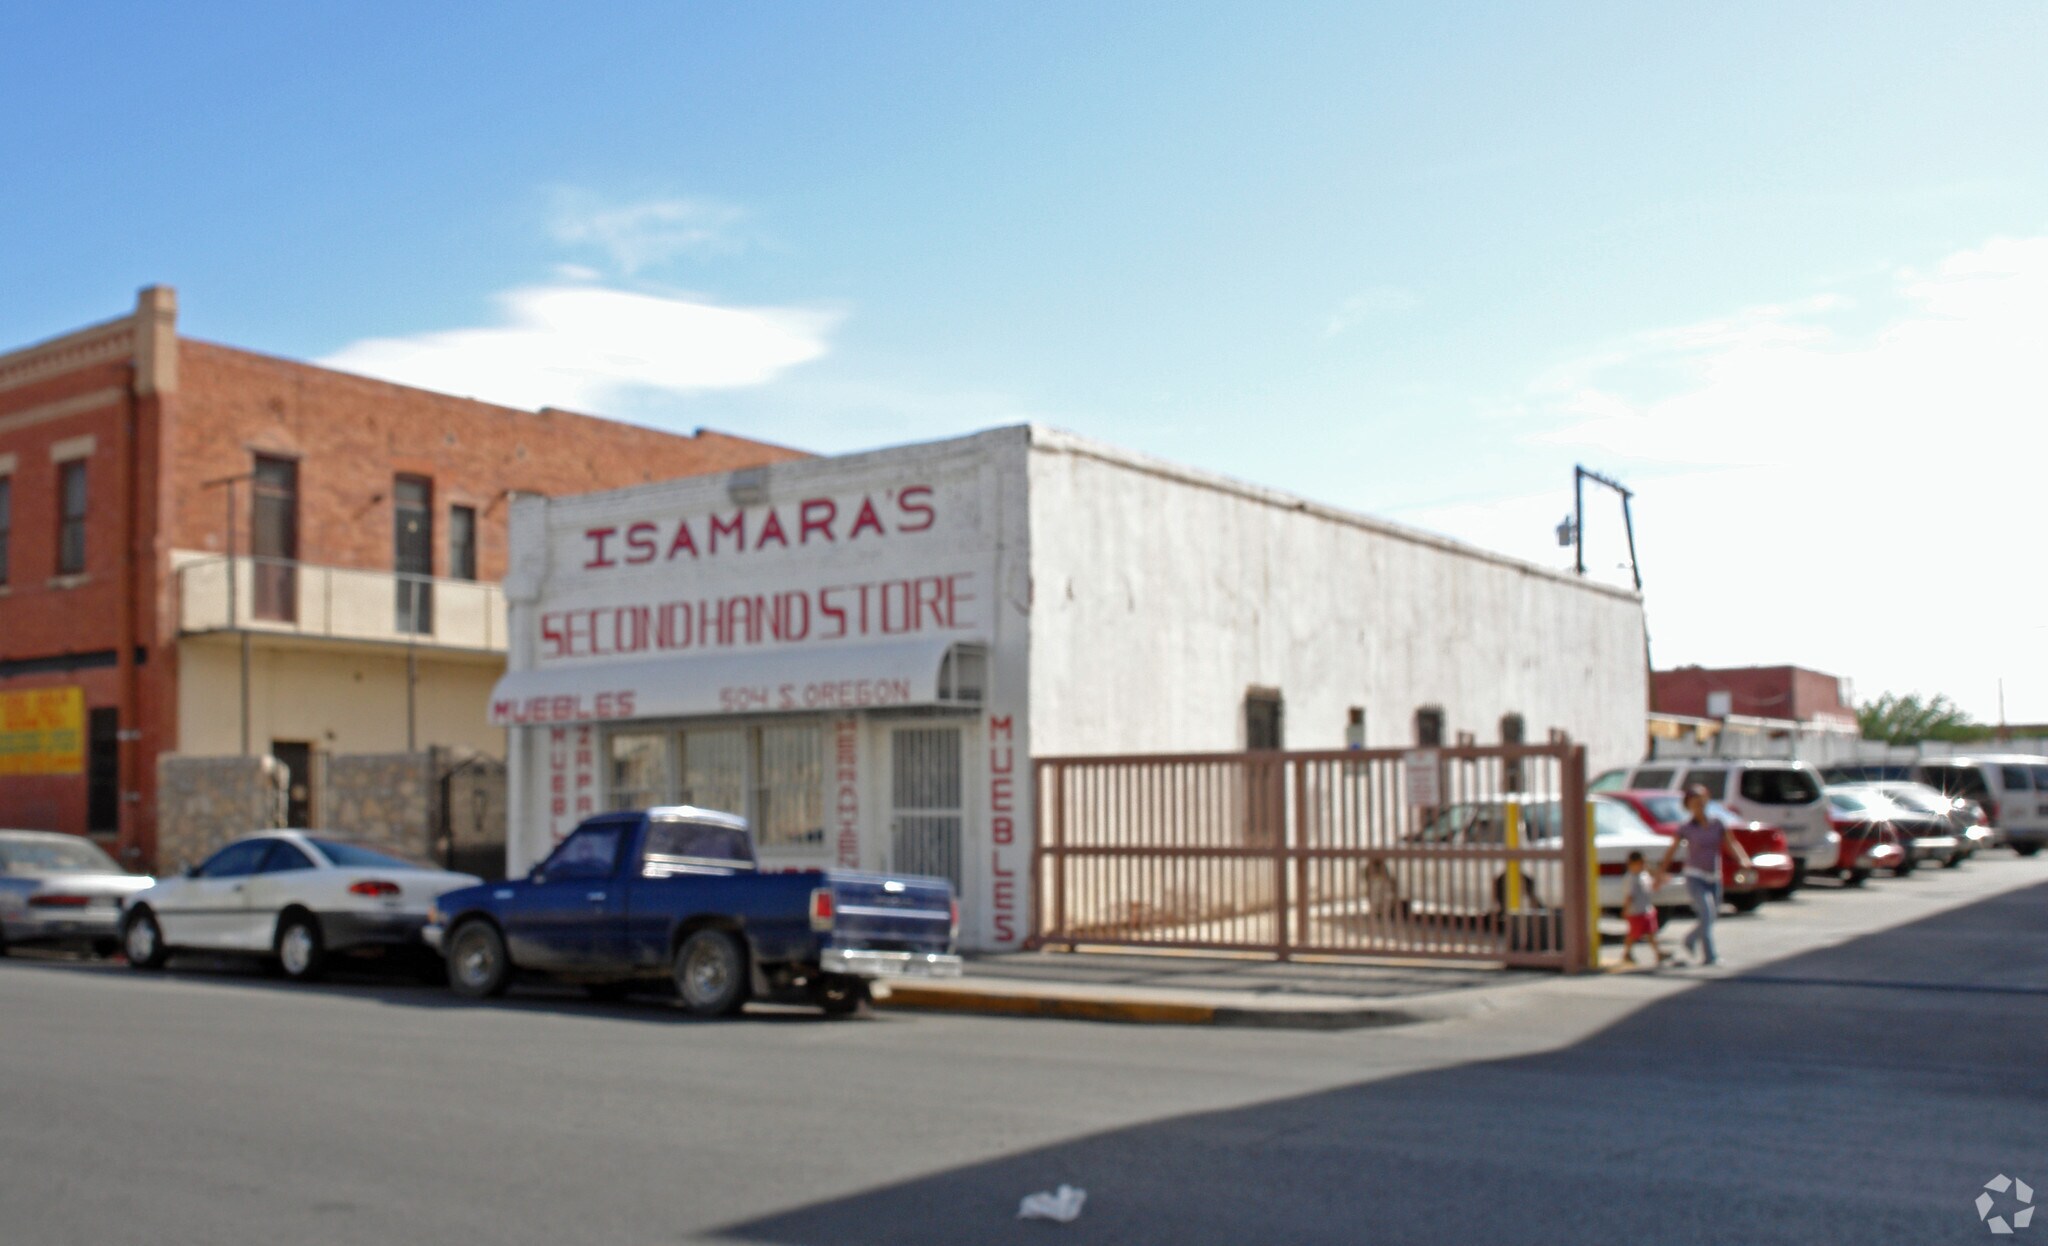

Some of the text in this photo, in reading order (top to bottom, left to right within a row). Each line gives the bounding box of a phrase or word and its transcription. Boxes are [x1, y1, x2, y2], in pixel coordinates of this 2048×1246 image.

[584, 484, 936, 570] ISAMARA'S
[820, 572, 978, 641] STORE
[493, 690, 636, 723] MUEBLES
[719, 686, 768, 713] 504
[802, 678, 911, 709] OREGON
[990, 715, 1015, 942] MUEBLES
